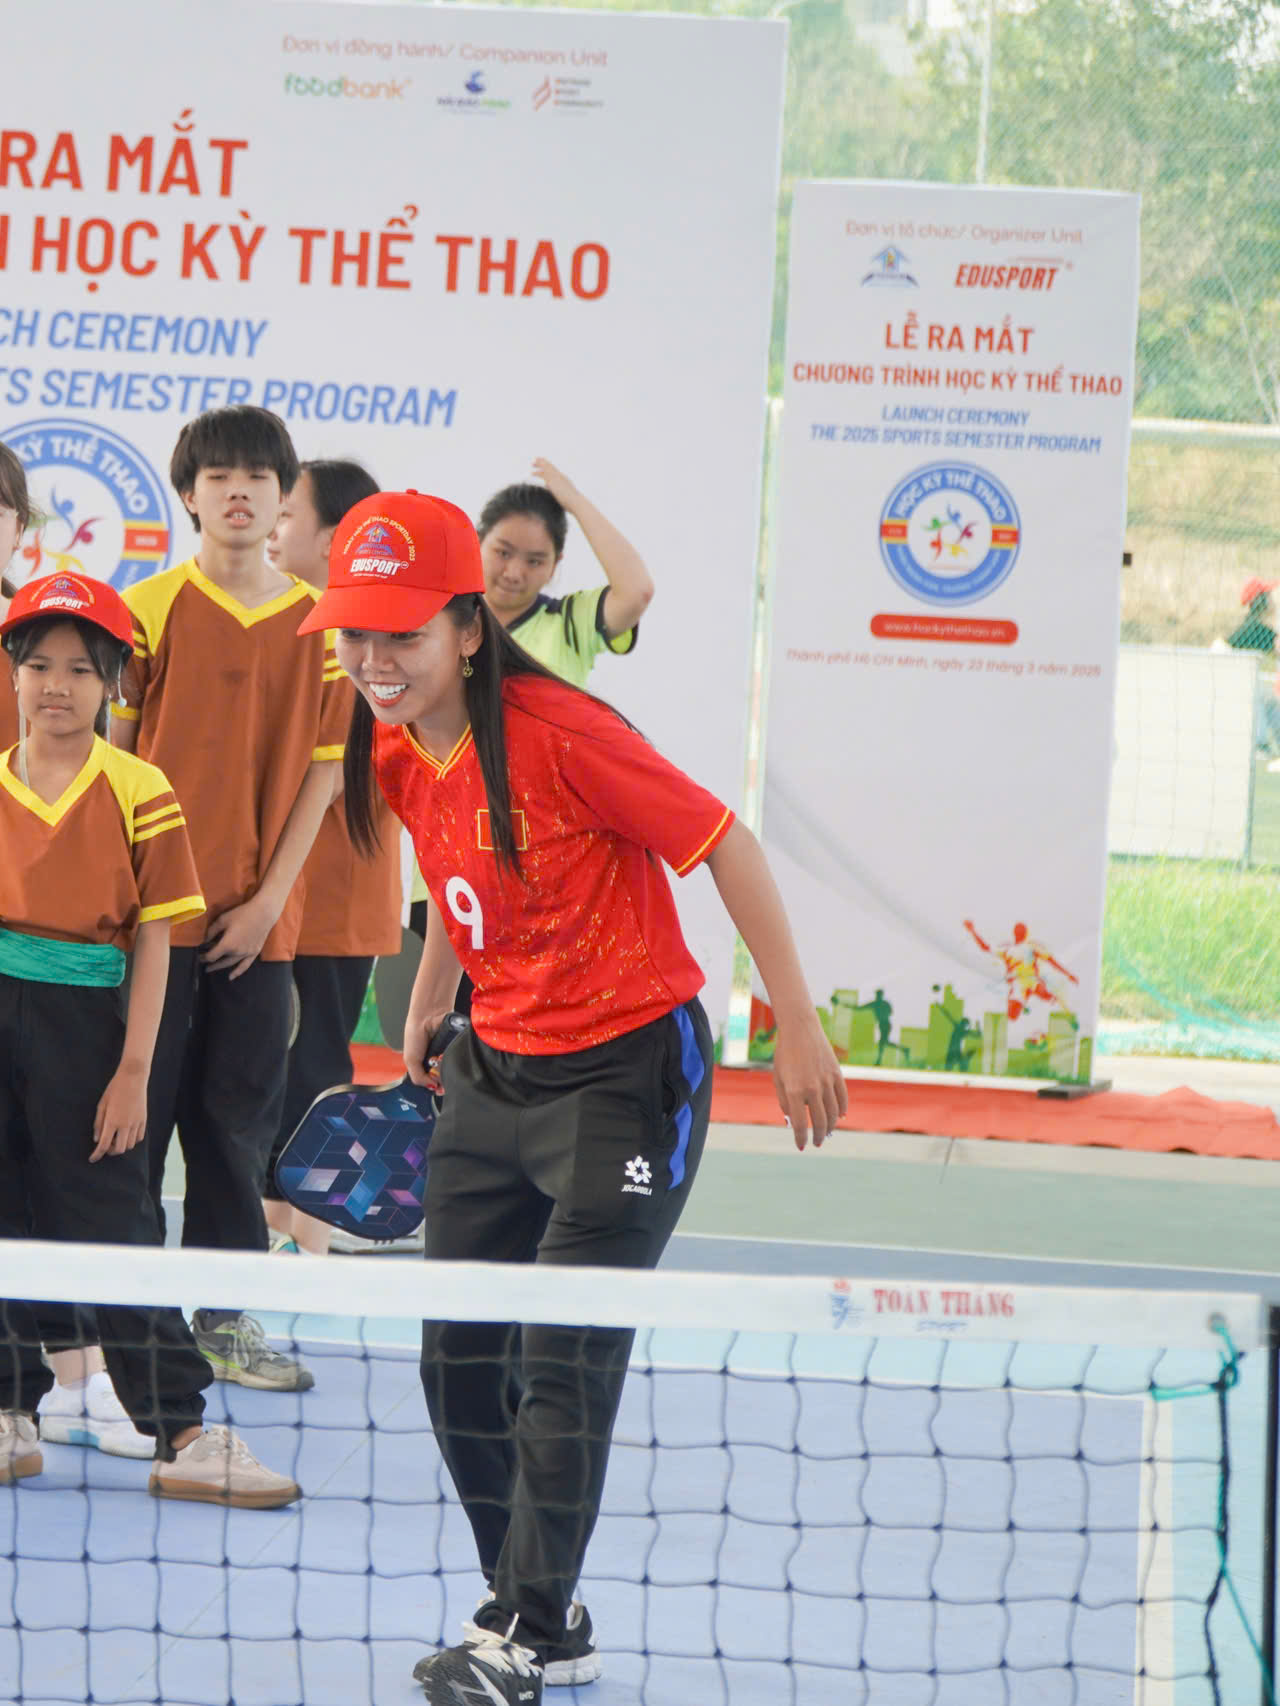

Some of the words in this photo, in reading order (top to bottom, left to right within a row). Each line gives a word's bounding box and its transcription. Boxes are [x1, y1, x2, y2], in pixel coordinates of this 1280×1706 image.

[460, 44, 565, 64] Companion
[570, 48, 609, 66] Unit
[107, 109, 248, 197] MẮT
[970, 223, 1046, 244] Organizer
[1051, 227, 1083, 244] Unit
[32, 216, 158, 292] HỌC
[181, 210, 266, 281] KỲ
[288, 205, 418, 289] THỂ
[435, 235, 609, 300] THAO
[956, 264, 1057, 289] EDUSPORT
[48, 310, 268, 357] CEREMONY
[885, 311, 919, 350] LỄ
[928, 325, 964, 350] RA
[974, 314, 1034, 354] MẮT
[40, 366, 254, 412] SEMESTER
[262, 378, 458, 428] PROGRAM
[794, 363, 874, 384] CHƯƠNG
[881, 363, 940, 387] TRÌNH
[945, 369, 986, 395] HỌC
[991, 369, 1018, 390] KỲ
[1025, 364, 1064, 393] THỂ
[1070, 375, 1122, 395] THAO
[881, 404, 945, 425] LAUNCH
[946, 407, 1031, 428] CEREMONY
[810, 424, 838, 441] THE
[842, 426, 879, 443] 2025
[882, 427, 942, 447] SPORTS
[943, 430, 1025, 450] SEMESTER
[1026, 434, 1102, 454] PROGRAM
[99, 451, 150, 514] THAO
[350, 558, 400, 575] EDUSPORT
[445, 875, 484, 950] 9
